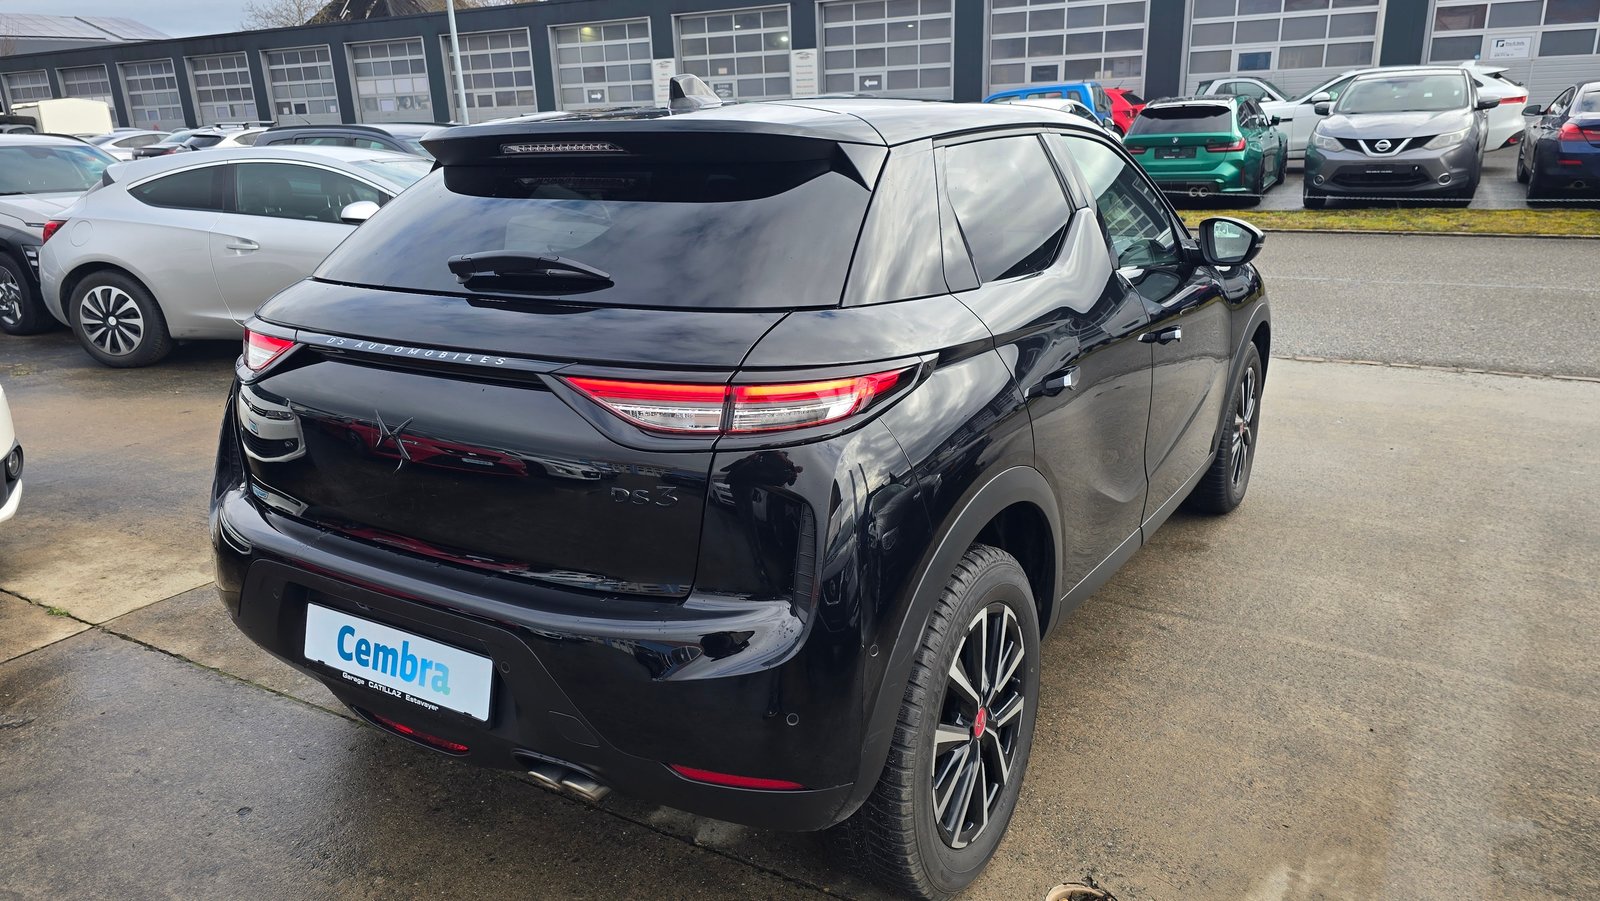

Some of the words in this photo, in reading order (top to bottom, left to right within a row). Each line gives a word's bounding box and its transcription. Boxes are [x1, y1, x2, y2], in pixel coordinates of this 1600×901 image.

[326, 337, 347, 345] DS
[355, 340, 506, 365] AUTOMOBILES
[337, 625, 450, 695] Cembra
[342, 671, 365, 685] Garage
[368, 681, 402, 698] CATILLAZ
[405, 694, 439, 711] Estavayer
